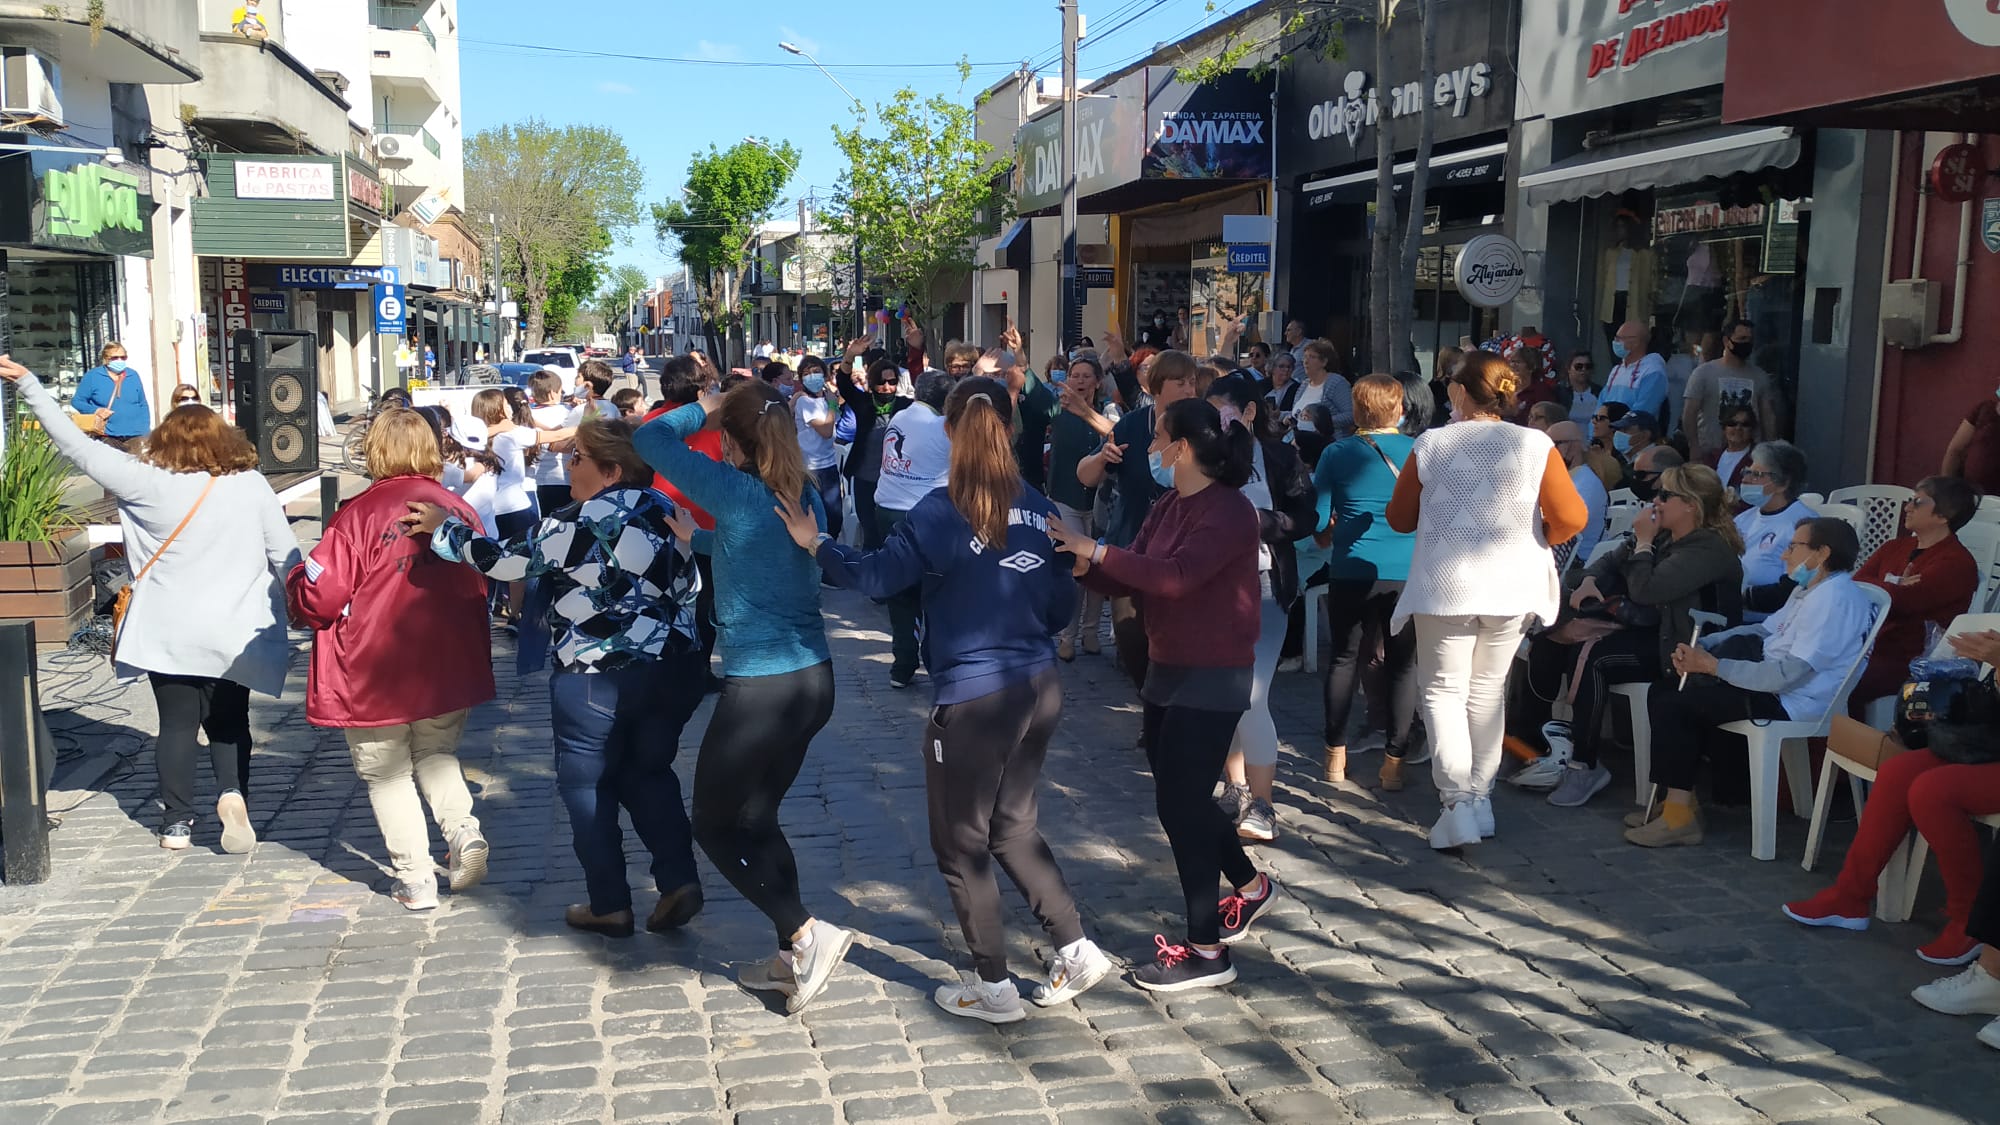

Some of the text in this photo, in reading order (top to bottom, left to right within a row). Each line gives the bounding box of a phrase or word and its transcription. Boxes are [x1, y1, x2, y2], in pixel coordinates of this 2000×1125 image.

[1587, 38, 1619, 78] DE
[1163, 111, 1262, 120] TIENDA Y ZAPATERIA
[1160, 120, 1265, 144] DAYMAX
[246, 166, 322, 180] FABRICA
[241, 182, 330, 196] de PASTAS
[1230, 251, 1267, 264] CREDITEL
[1467, 262, 1524, 285] Alejandro
[253, 297, 283, 308] CREDITEL
[385, 301, 395, 316] E
